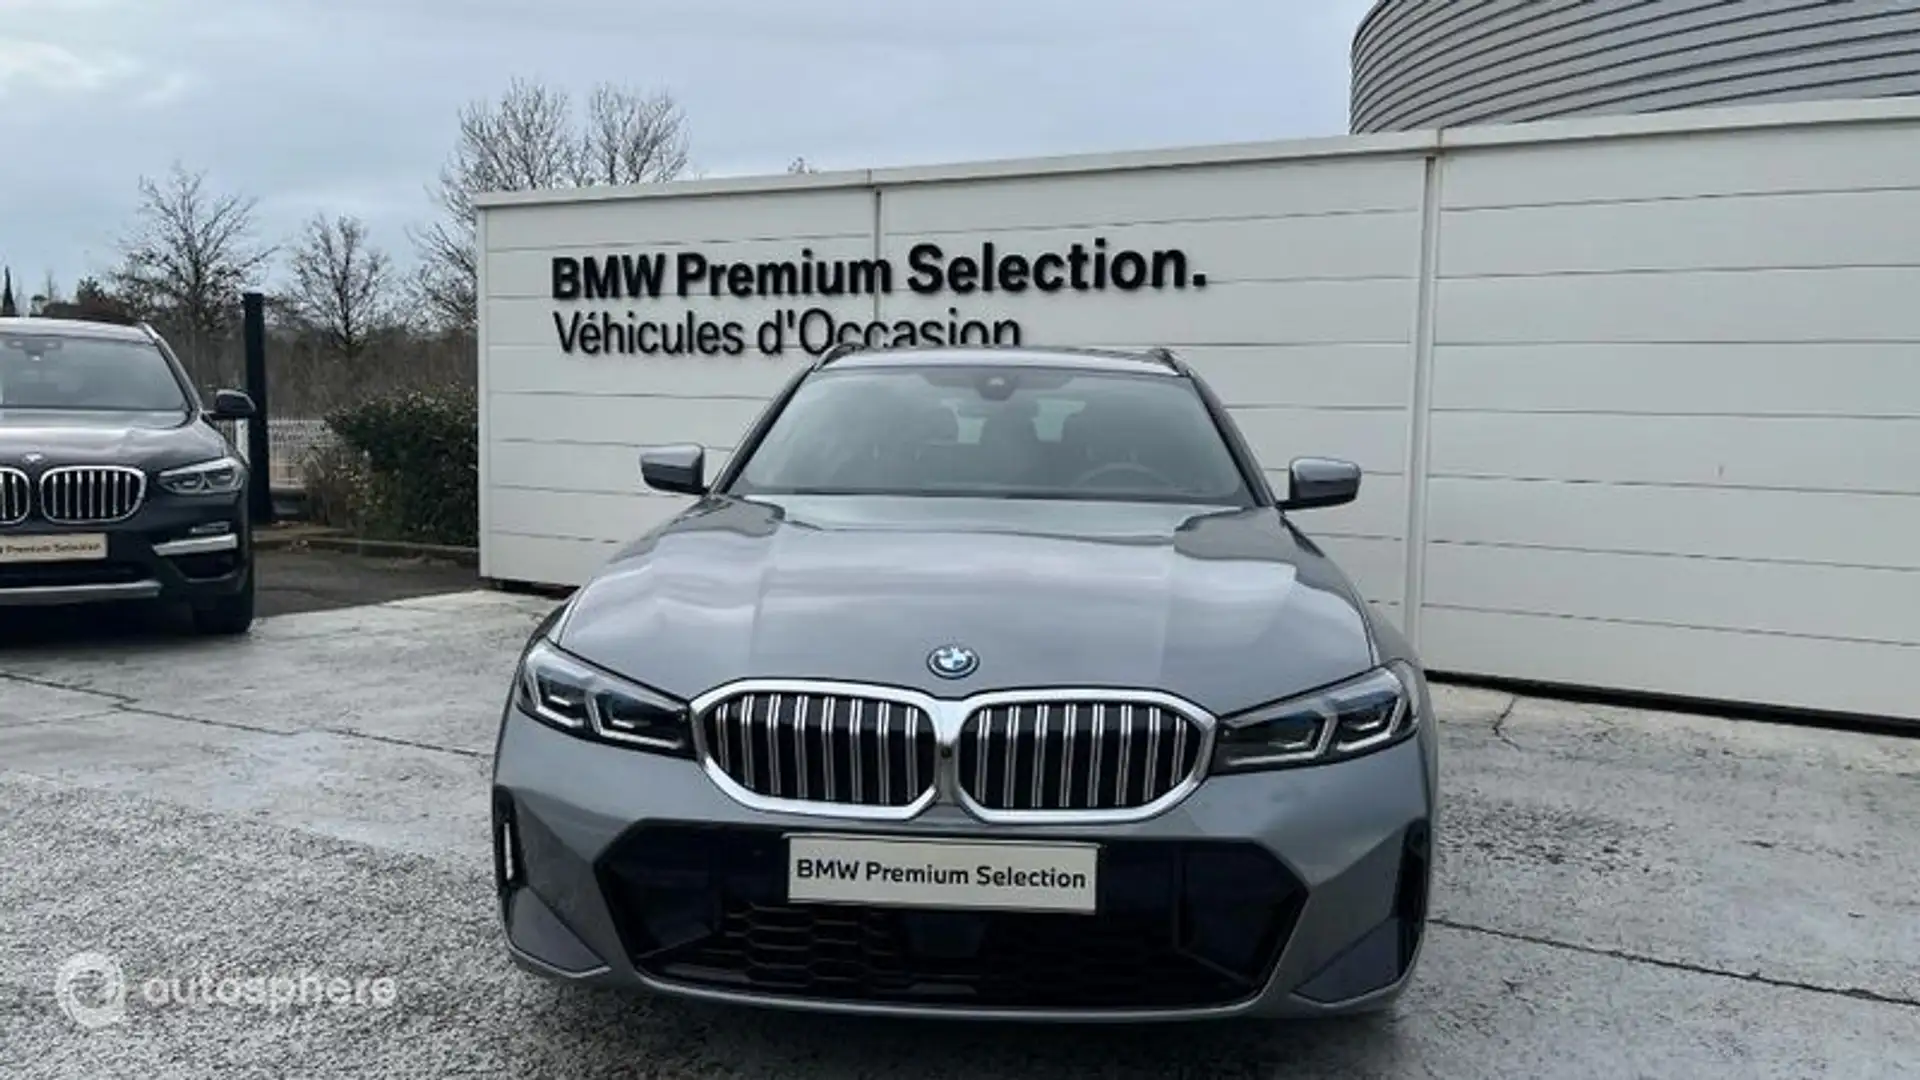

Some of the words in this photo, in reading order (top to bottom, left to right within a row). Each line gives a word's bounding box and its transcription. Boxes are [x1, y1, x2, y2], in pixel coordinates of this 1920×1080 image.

[551, 252, 665, 299] BMW
[676, 248, 892, 297] Premium
[906, 237, 1207, 295] Selection.
[552, 309, 745, 354] Véhicules
[757, 307, 1020, 355] d'Occasion
[796, 858, 860, 881] BMW
[866, 861, 969, 886] Premium
[976, 865, 1087, 889] Selection
